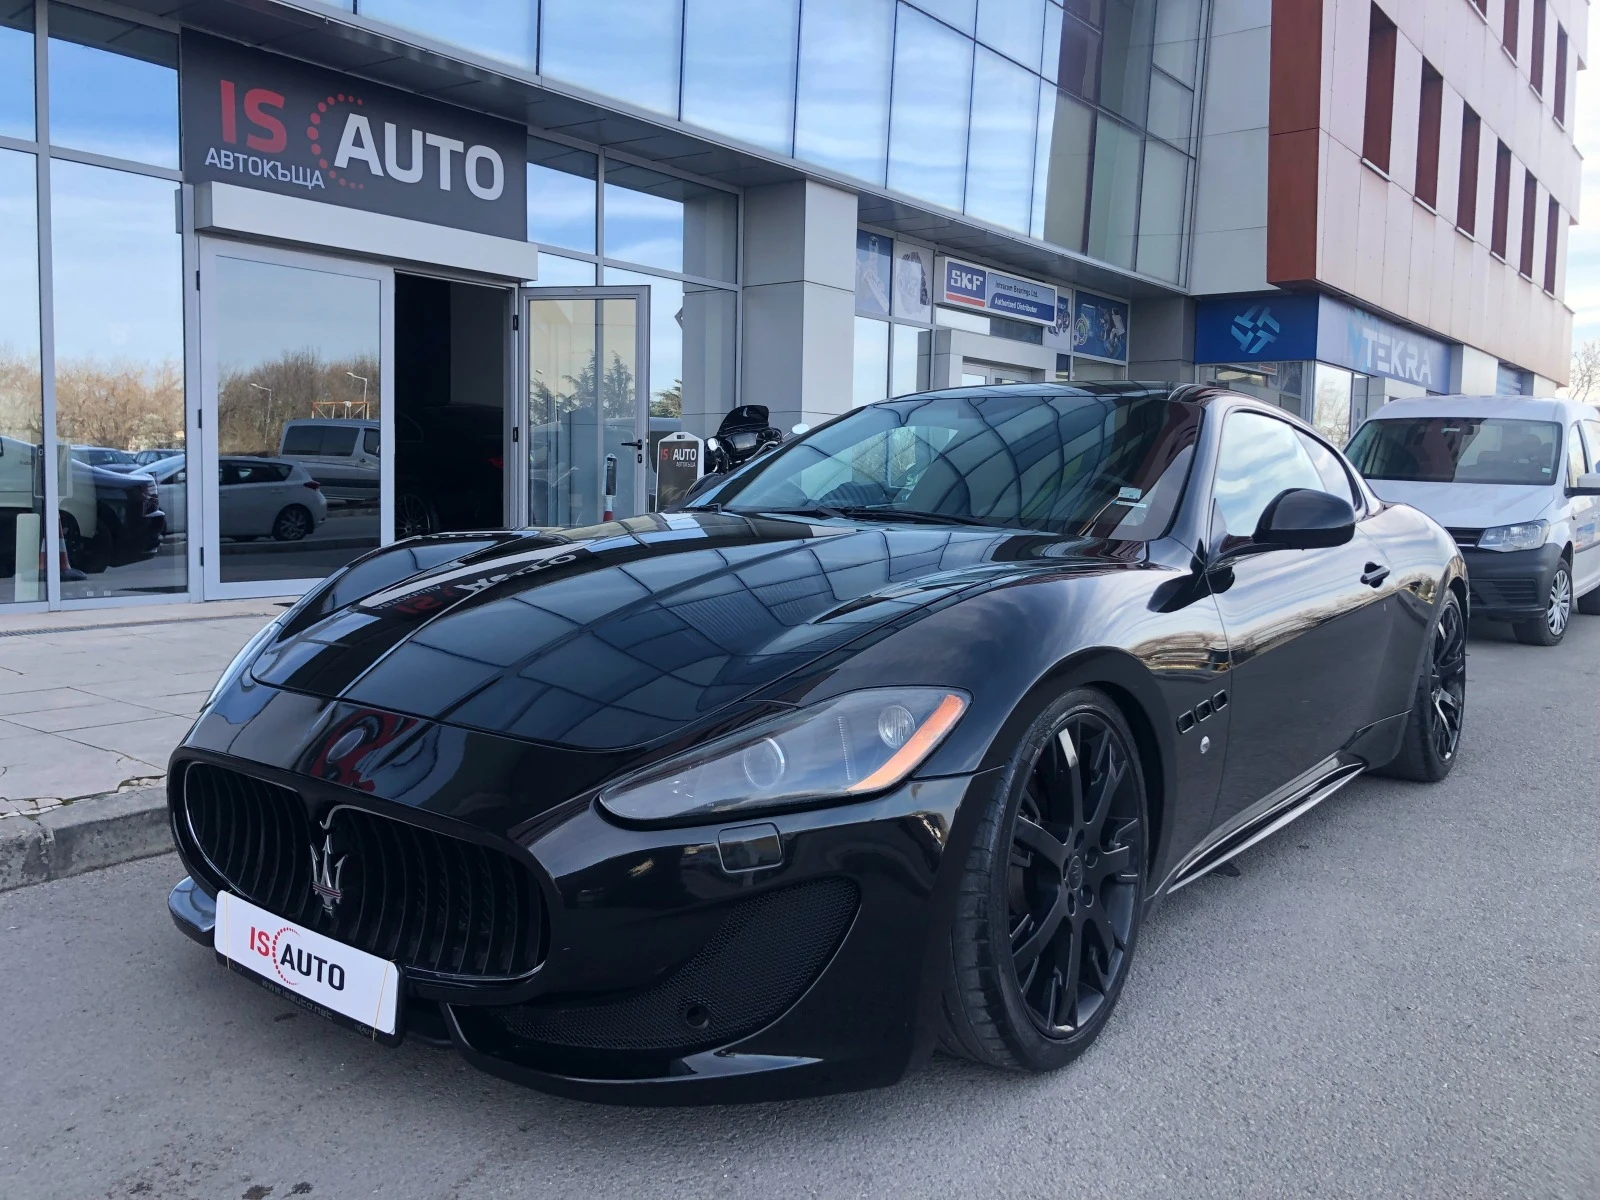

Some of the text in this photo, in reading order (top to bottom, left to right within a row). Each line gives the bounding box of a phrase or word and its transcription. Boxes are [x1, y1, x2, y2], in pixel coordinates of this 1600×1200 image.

[220, 79, 505, 201] IS AUTO
[204, 147, 326, 190] АВТОКЪЩА
[950, 269, 983, 291] SKF
[1362, 327, 1432, 385] TEKRA
[673, 448, 696, 461] AUTO
[249, 926, 345, 991] IS AUTO
[261, 979, 333, 1020] www.isauto.net
